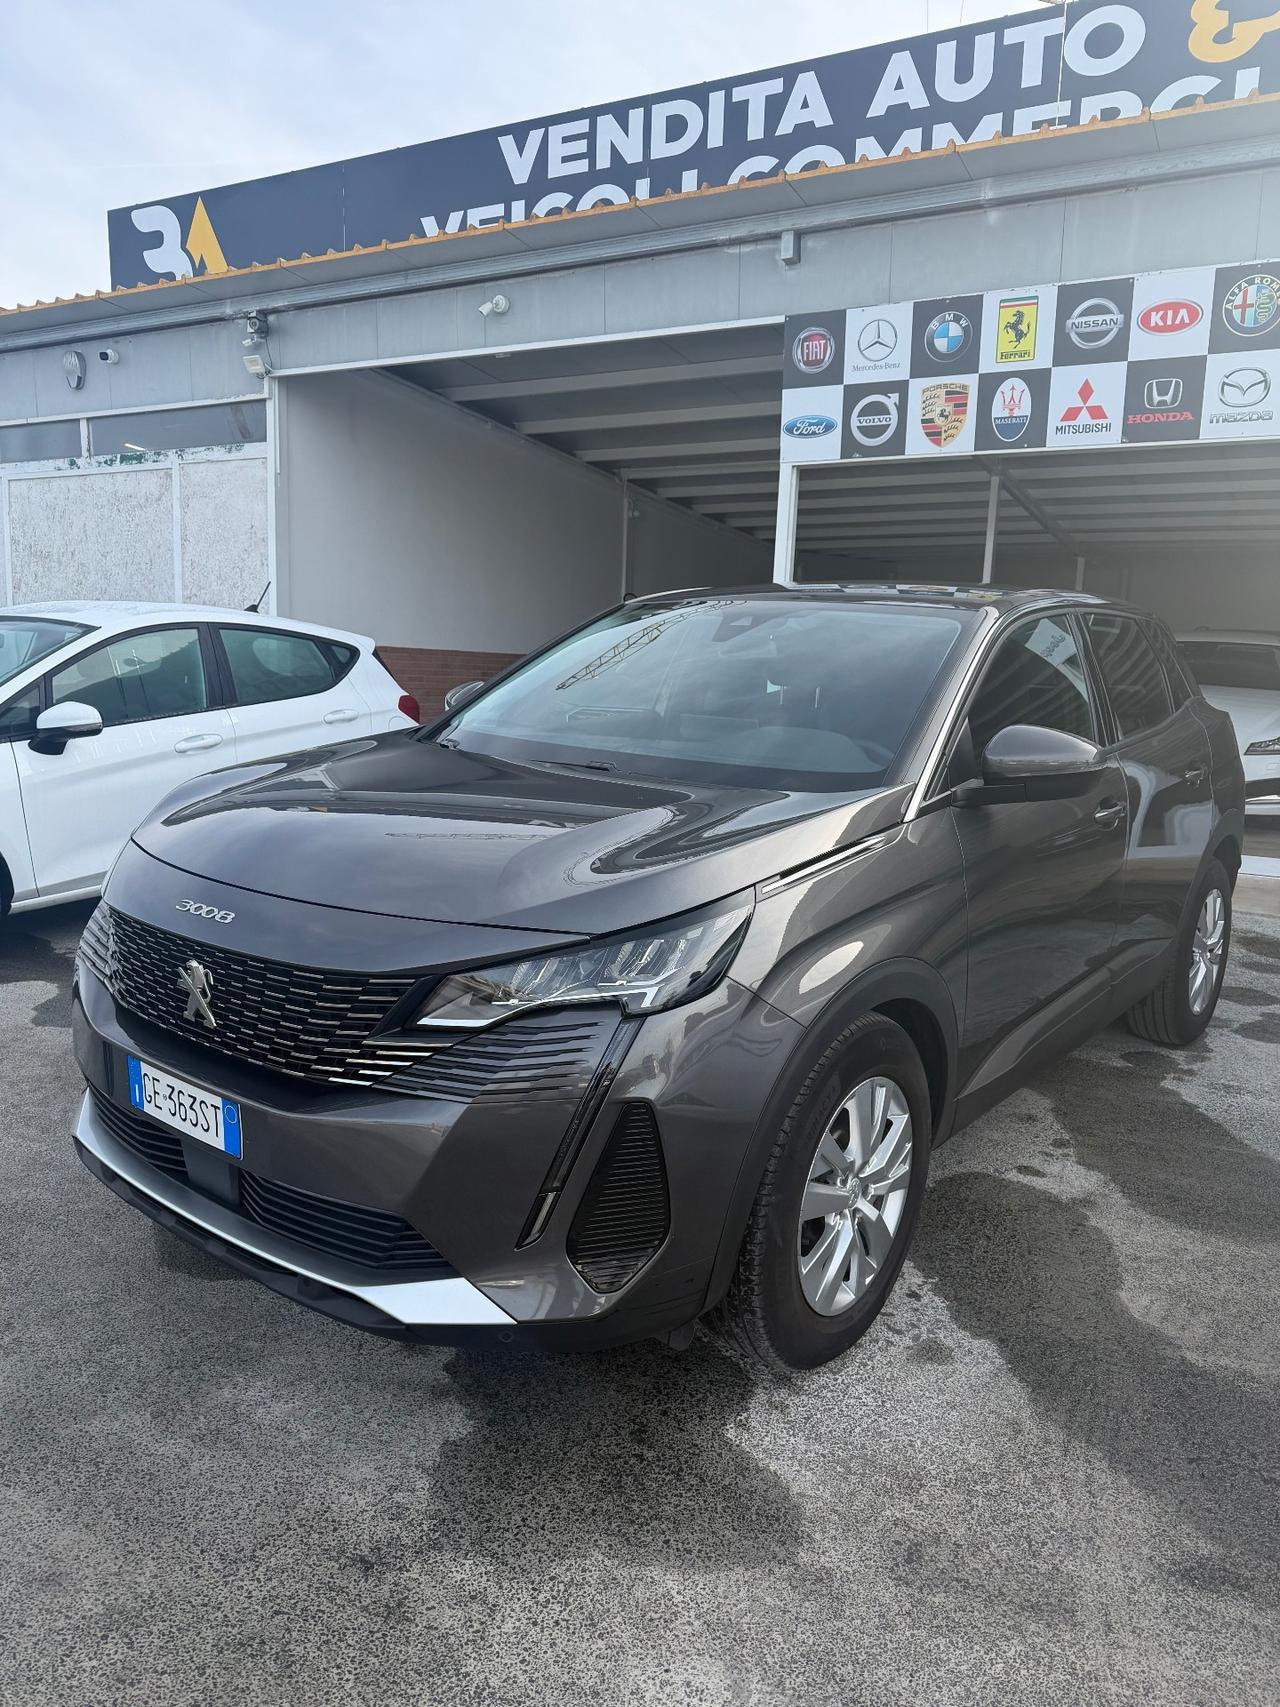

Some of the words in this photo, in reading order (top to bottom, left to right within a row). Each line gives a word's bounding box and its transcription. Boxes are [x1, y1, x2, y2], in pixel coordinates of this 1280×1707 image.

[497, 70, 834, 185] VENDITA
[866, 4, 1147, 119] AUTO
[1225, 281, 1249, 310] ALFA
[931, 313, 969, 330] BMW
[1071, 317, 1119, 330] NISSAN
[1150, 308, 1190, 327] KIA
[803, 339, 826, 361] FIAT
[1000, 350, 1031, 360] Ferrari
[852, 362, 901, 372] Mercedes-Benz
[921, 382, 969, 394] PORSCHE
[857, 416, 892, 425] VOLVO
[994, 416, 1027, 425] MASERATI
[1127, 411, 1195, 424] HONDA
[792, 418, 826, 435] Ford
[1055, 422, 1112, 435] MITSUBISHI
[175, 899, 236, 924] 3008
